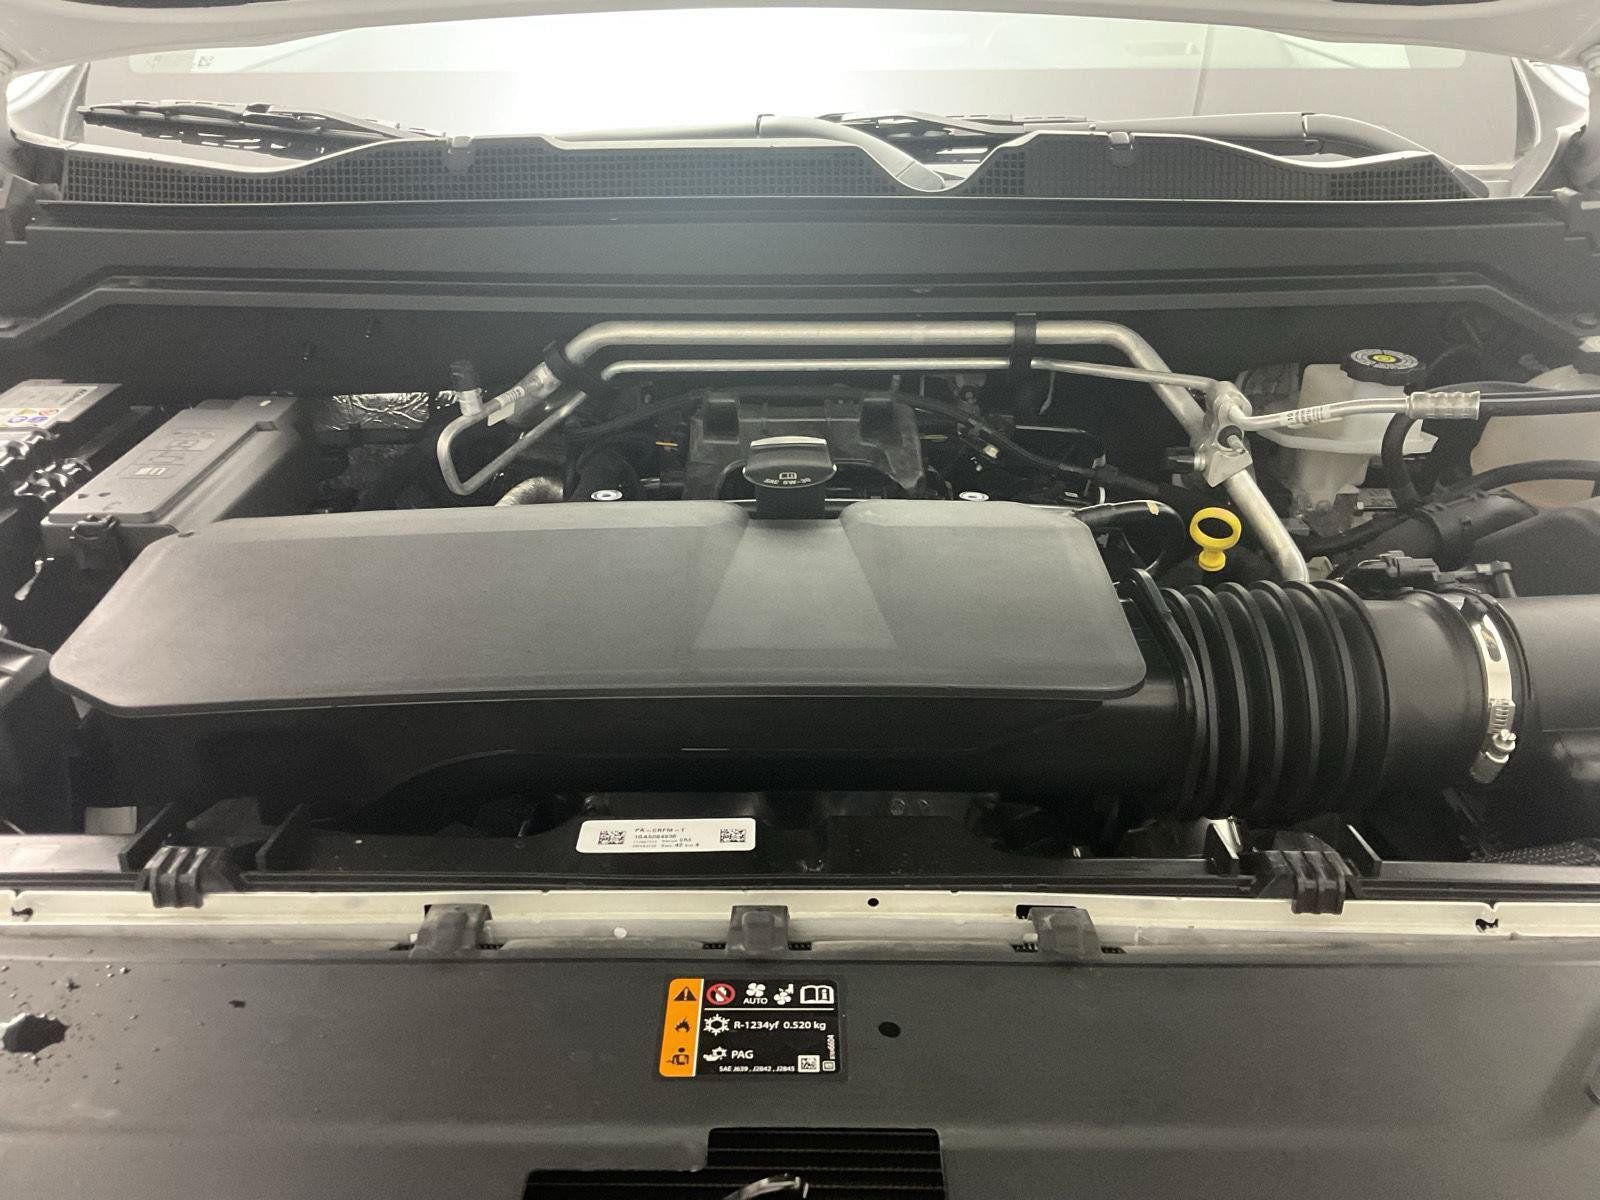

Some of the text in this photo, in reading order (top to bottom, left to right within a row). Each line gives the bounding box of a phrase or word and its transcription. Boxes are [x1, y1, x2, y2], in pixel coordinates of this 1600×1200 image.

[743, 997, 768, 1005] AUTO
[733, 1020, 827, 1031] R-1234yf 0.520 kg
[731, 1049, 754, 1060] PAG
